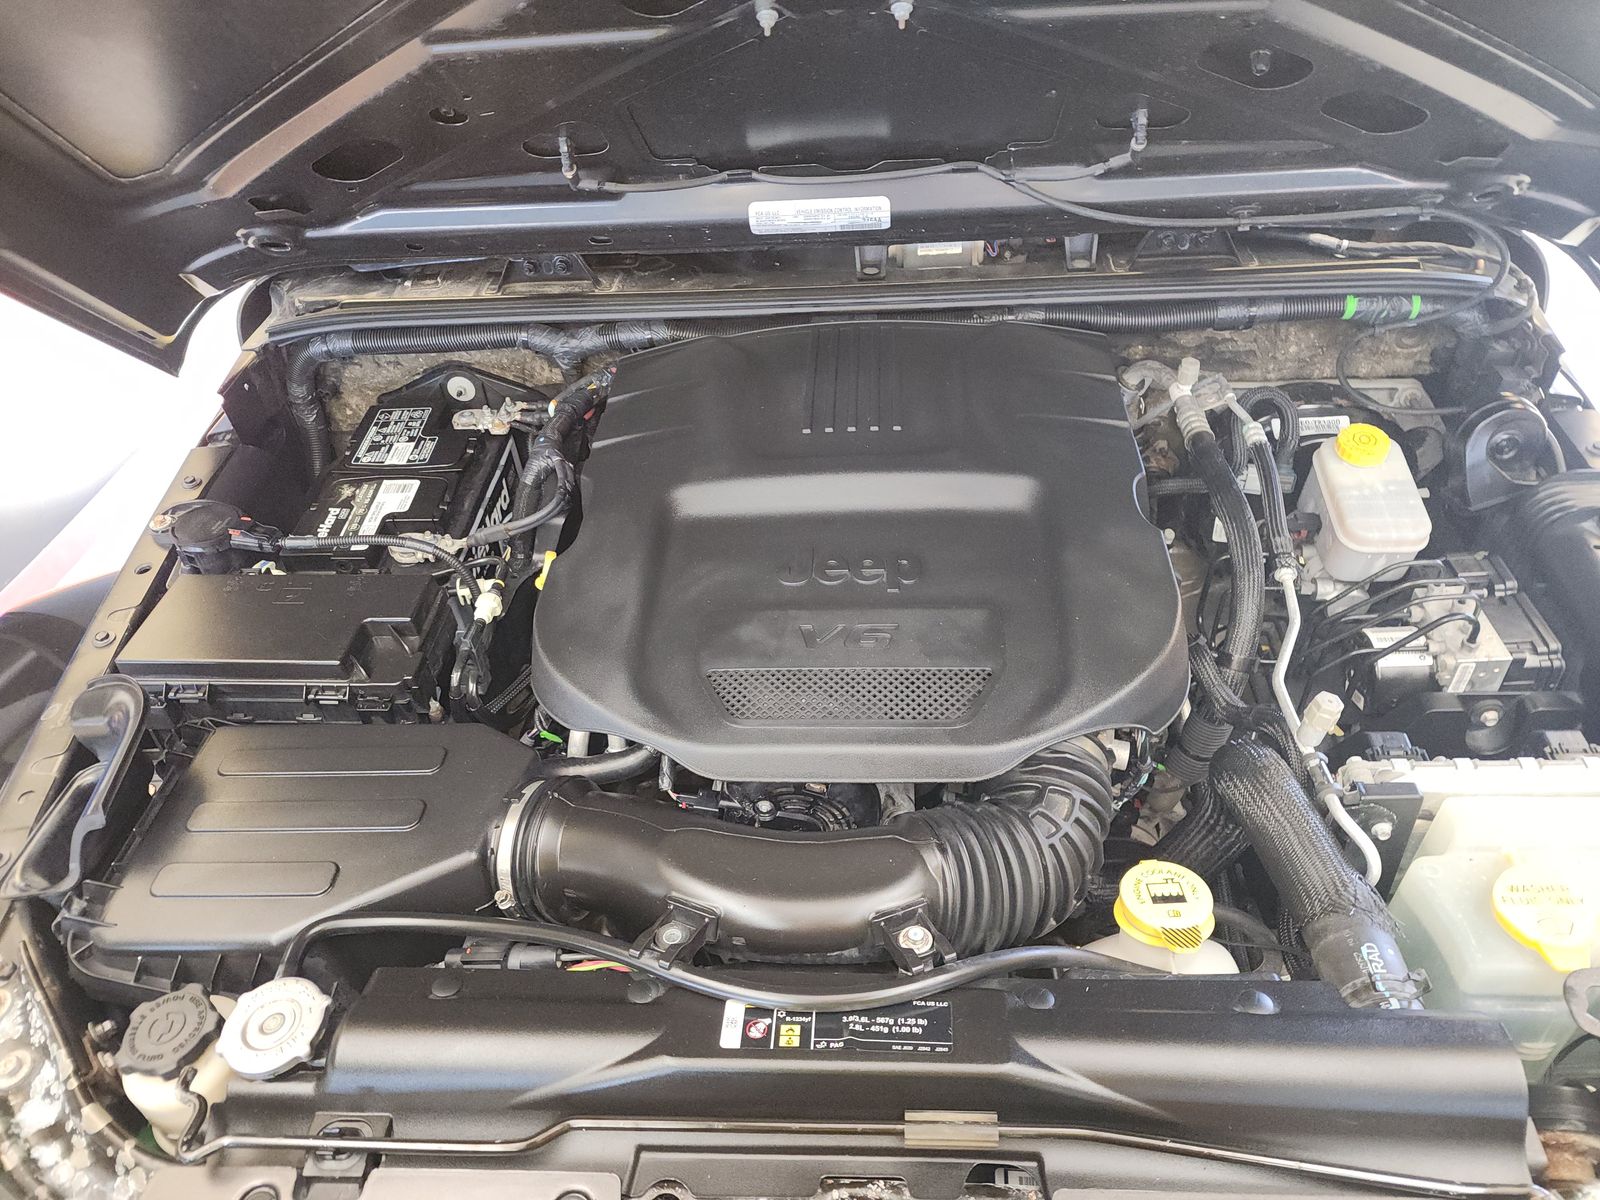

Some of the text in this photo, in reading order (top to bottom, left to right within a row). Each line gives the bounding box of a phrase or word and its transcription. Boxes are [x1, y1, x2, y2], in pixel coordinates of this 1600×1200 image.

[776, 548, 920, 594] Jeep
[799, 623, 899, 649] V6
[785, 1015, 812, 1023] R-1234yf
[875, 1016, 895, 1026] 567g
[897, 1017, 917, 1026] (1.25
[916, 1018, 928, 1027] lb)
[870, 1025, 889, 1034] 451g
[891, 1025, 911, 1035] (1.00
[911, 1026, 923, 1035] lb)
[829, 1040, 845, 1050] PAG
